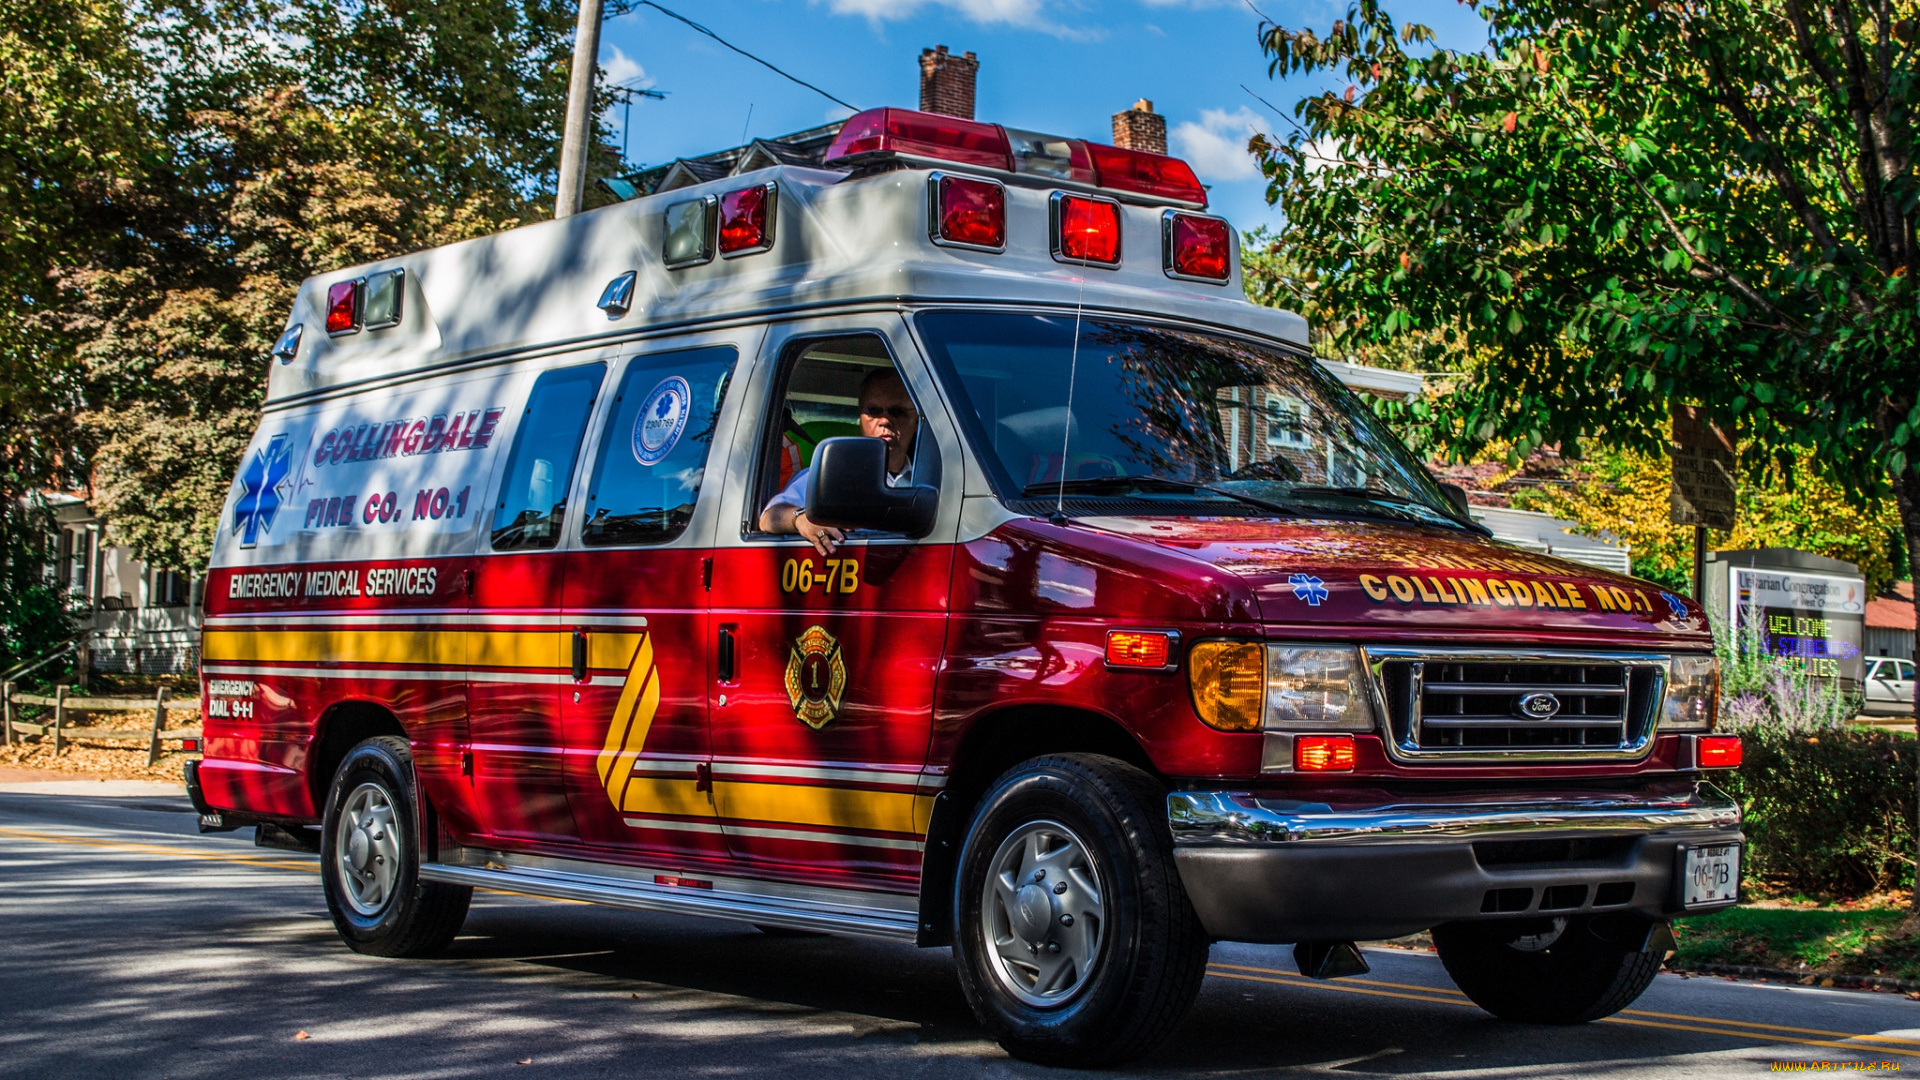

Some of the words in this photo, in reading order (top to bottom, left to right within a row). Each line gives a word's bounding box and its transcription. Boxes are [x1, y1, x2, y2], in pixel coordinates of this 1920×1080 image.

[314, 407, 505, 467] COLLINGDALE
[304, 495, 356, 528] FIRE
[363, 491, 402, 524] CO.
[412, 485, 471, 520] NO.1
[229, 571, 302, 598] EMERGENCY
[305, 569, 361, 597] MEDICAL
[366, 567, 437, 596] SERVICES
[782, 558, 859, 593] 06-7B
[1782, 577, 1840, 599] Congregation
[1359, 573, 1587, 609] COLLINGDALE
[1590, 584, 1653, 614] NO.1
[1768, 615, 1833, 638] WELCOME
[811, 661, 819, 688] 1
[209, 679, 254, 696] EMERGENCY
[209, 702, 229, 718] DIAL
[232, 701, 253, 718] 9-1-1
[1532, 698, 1552, 711] Ford
[1694, 863, 1729, 887] 06-7B
